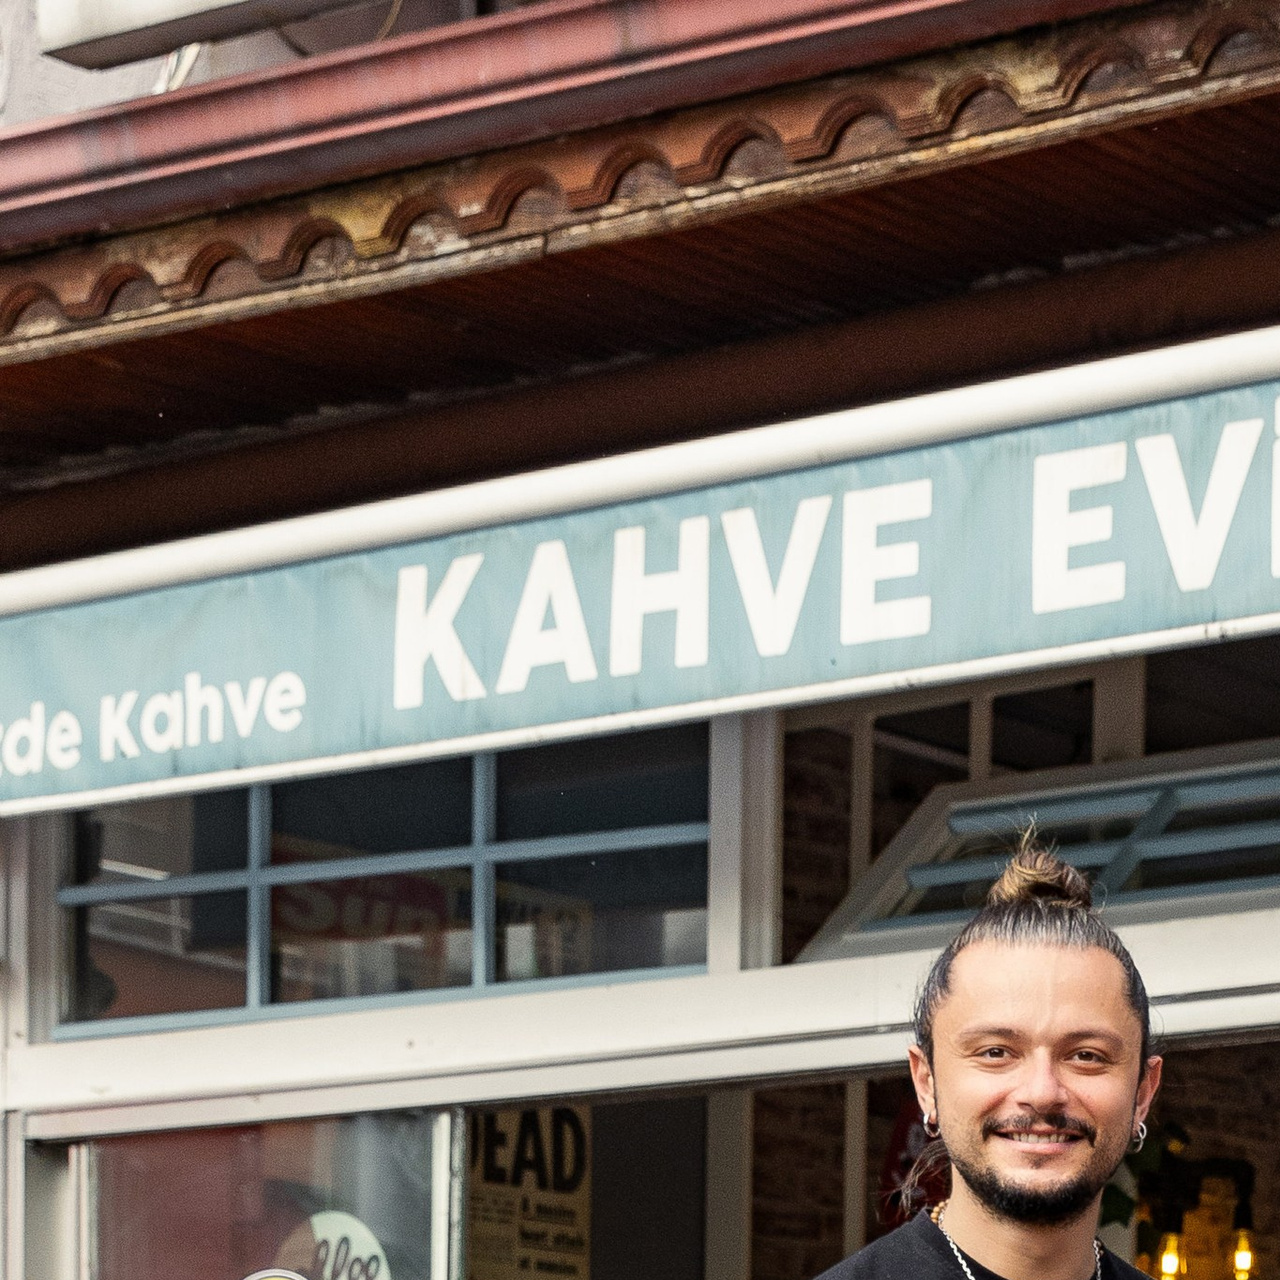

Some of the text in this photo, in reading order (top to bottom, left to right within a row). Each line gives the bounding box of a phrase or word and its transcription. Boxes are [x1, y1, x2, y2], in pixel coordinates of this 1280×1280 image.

[393, 478, 933, 710] KAHVE
[0, 670, 307, 776] de Kahve
